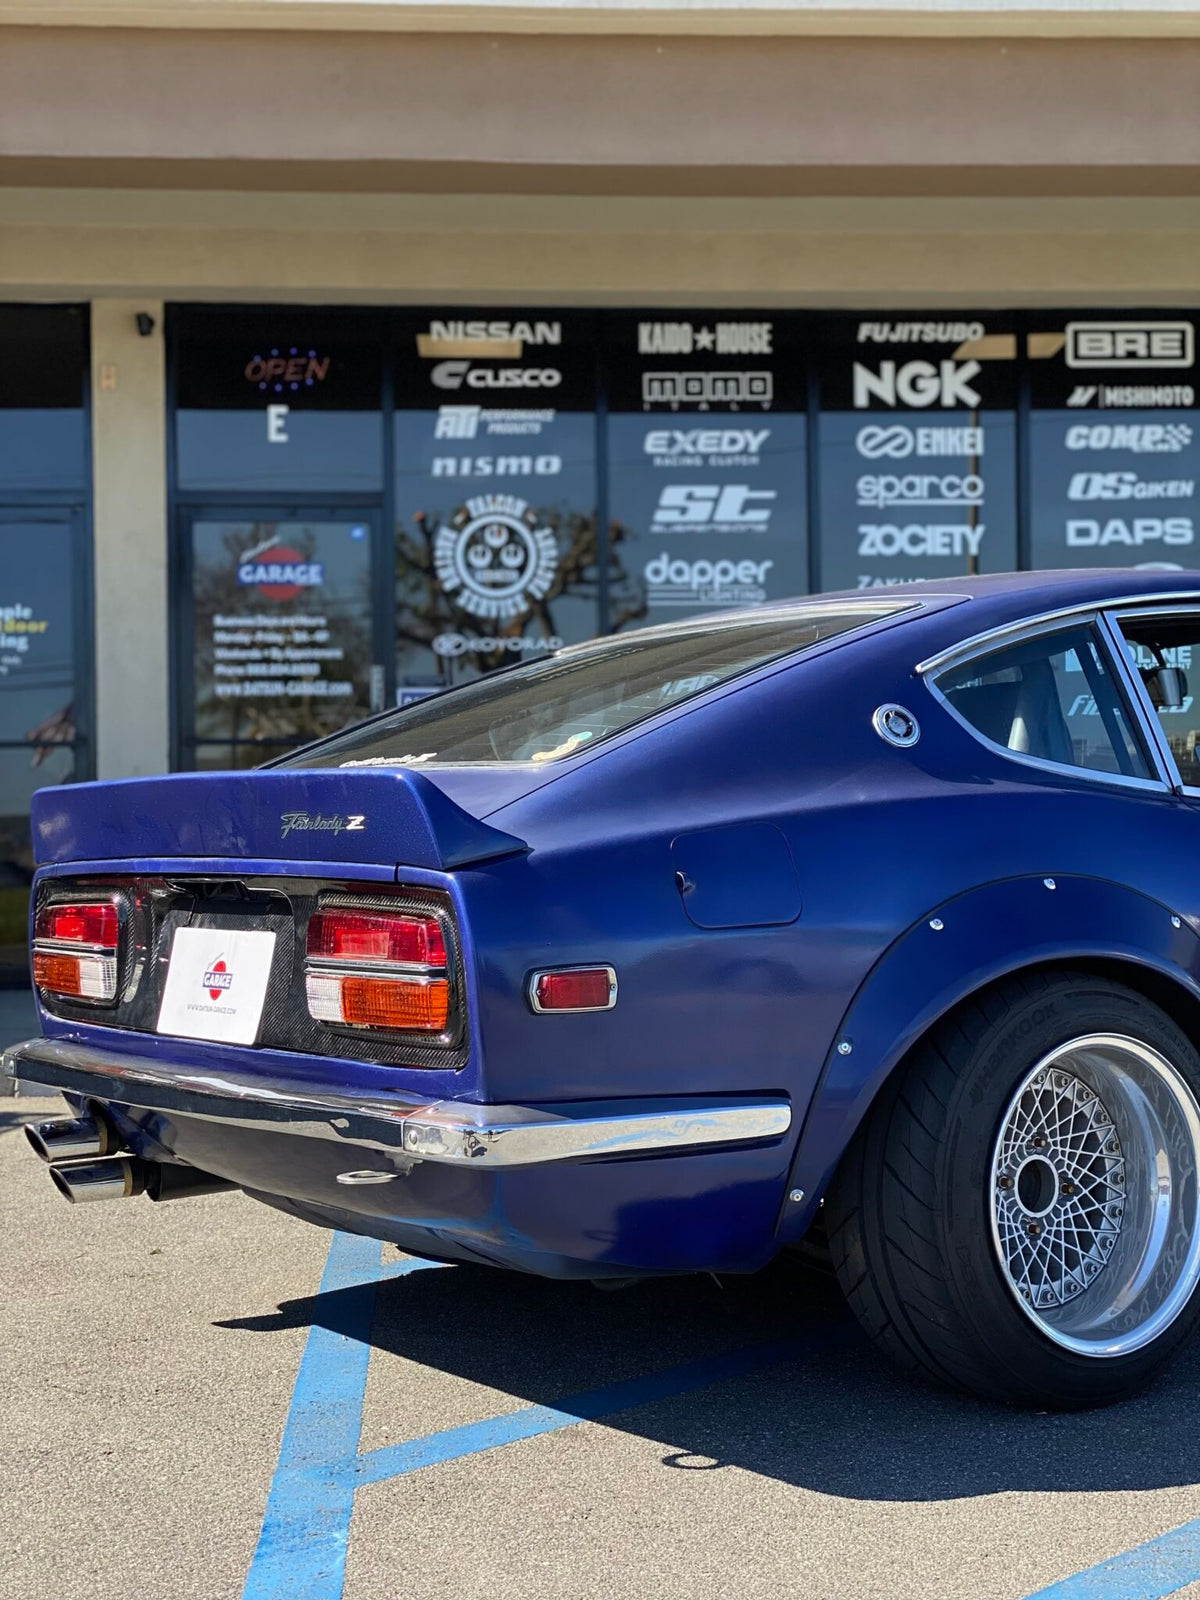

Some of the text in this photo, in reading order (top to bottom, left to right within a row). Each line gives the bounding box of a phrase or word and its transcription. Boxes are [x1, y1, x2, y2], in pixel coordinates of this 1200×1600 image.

[429, 320, 562, 344] NISSAN
[638, 322, 773, 354] KAIDO HOUSE
[857, 321, 985, 343] FUJITSUBO
[1076, 331, 1183, 358] BRE
[244, 357, 330, 381] OPEN
[466, 368, 562, 388] CUSCO
[853, 359, 982, 408] NGK
[1104, 385, 1195, 407] MISHIMOTO
[267, 404, 289, 443] E
[645, 428, 771, 455] EXEDY
[916, 427, 985, 456] ENKEI
[857, 475, 985, 508] sparco
[858, 524, 986, 556] ZOCIETY
[1066, 517, 1194, 546] DAPS
[239, 564, 323, 583] GARAGE
[645, 552, 773, 590] dapper
[345, 814, 366, 831] Z
